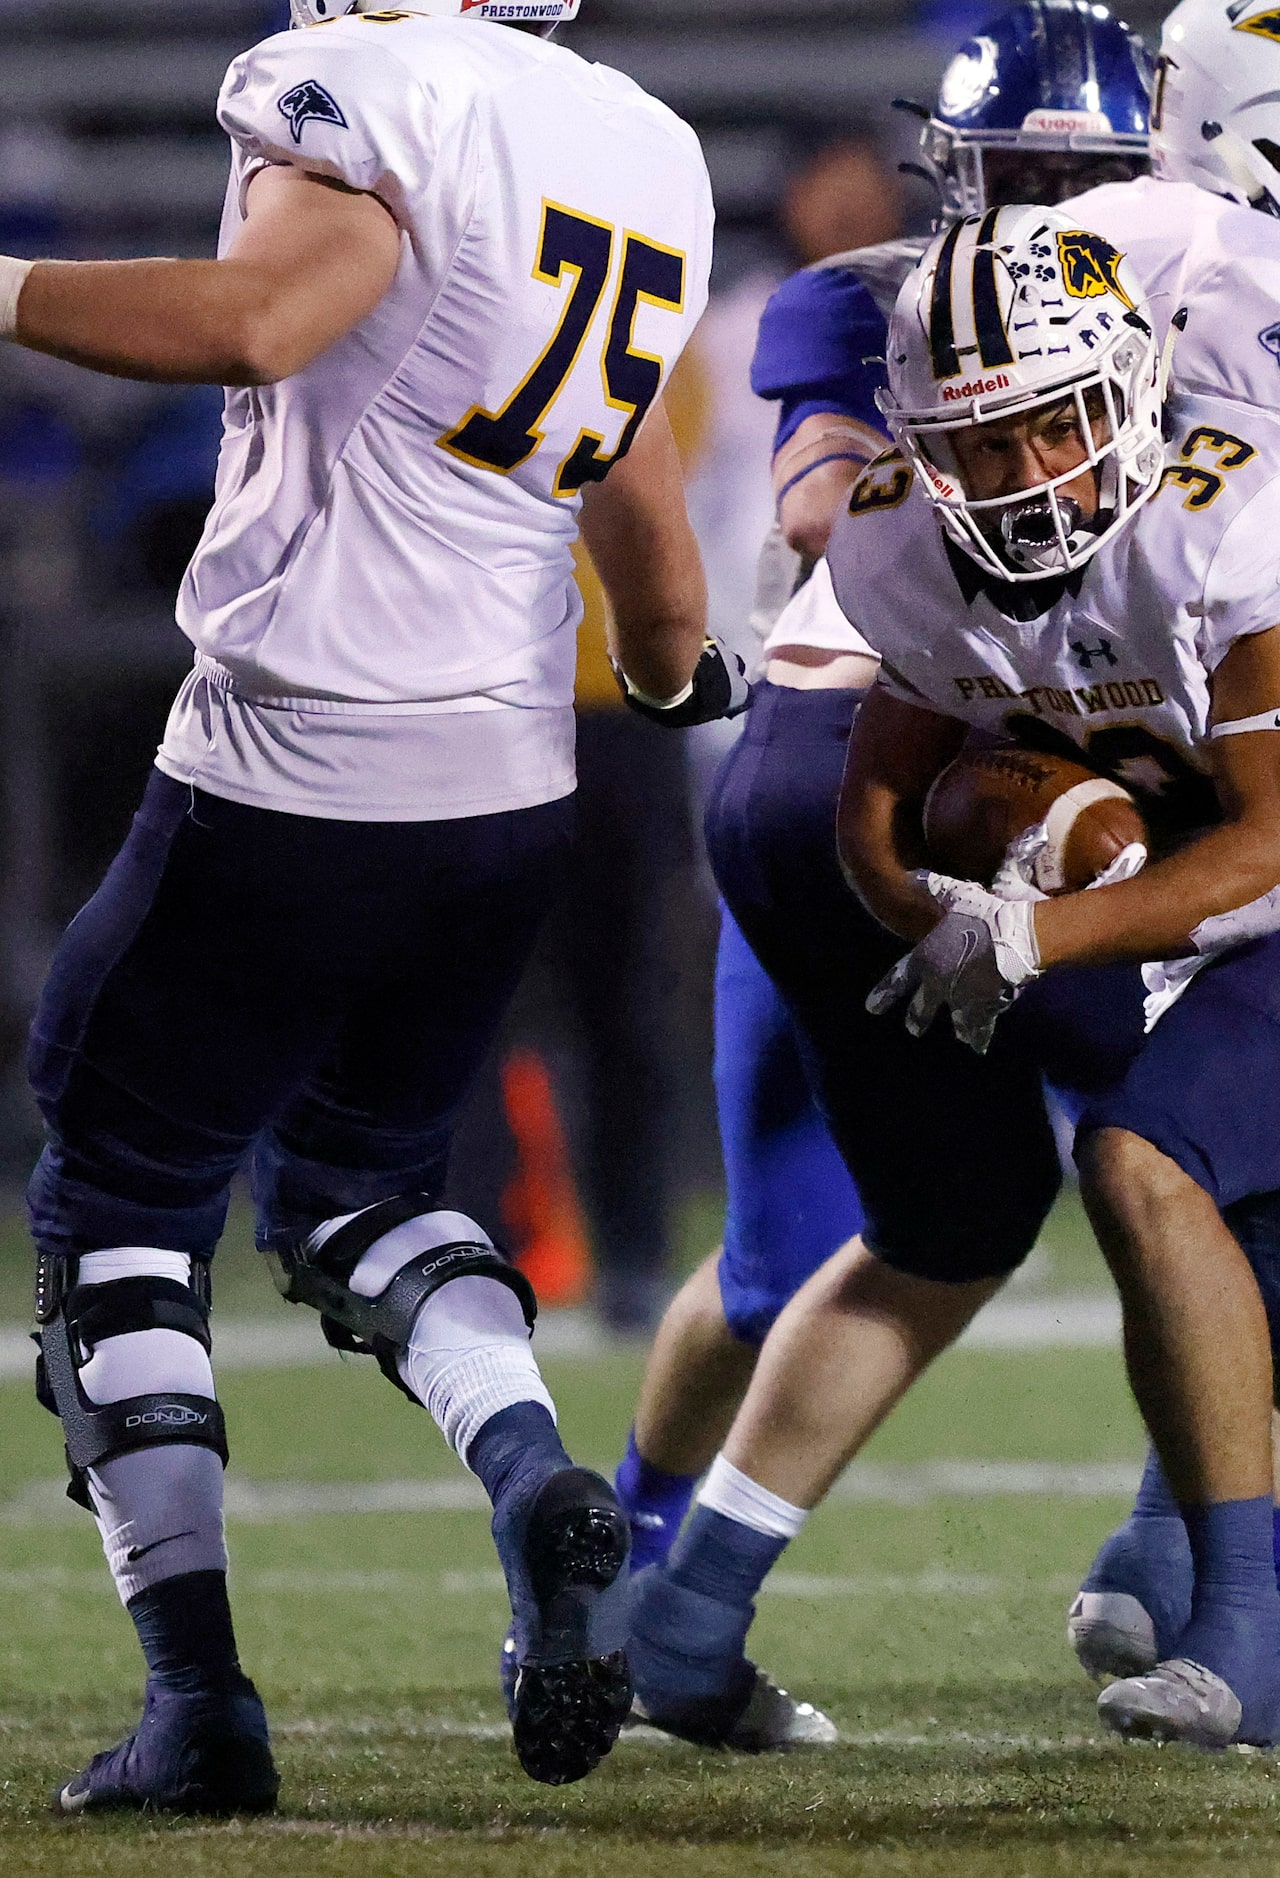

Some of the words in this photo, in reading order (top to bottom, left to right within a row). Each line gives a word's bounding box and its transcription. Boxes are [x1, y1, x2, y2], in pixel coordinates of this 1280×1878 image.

[480, 4, 564, 17] PRESTONWOOD
[434, 196, 686, 497] 75
[943, 374, 1010, 402] Riddell
[1148, 425, 1259, 512] 33
[953, 677, 1165, 714] PRTONWOOD
[422, 1247, 495, 1276] DONJO
[126, 1411, 207, 1428] DONJOY
